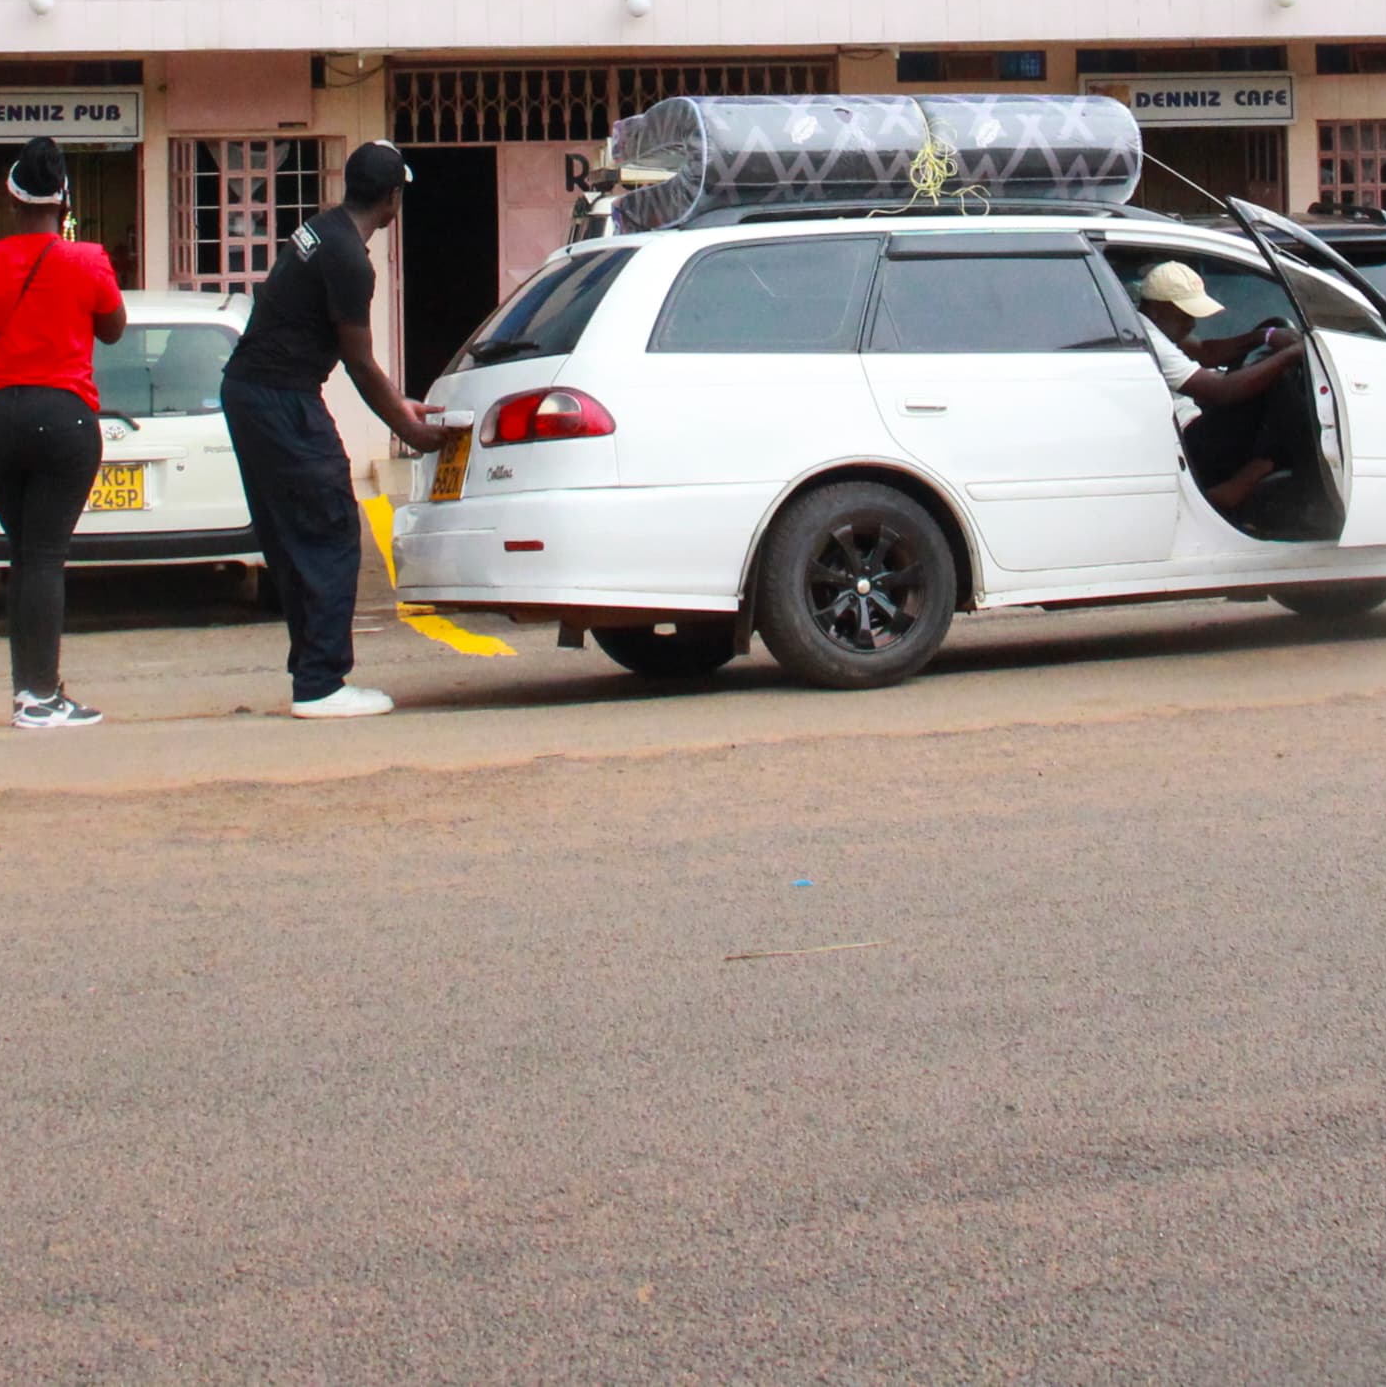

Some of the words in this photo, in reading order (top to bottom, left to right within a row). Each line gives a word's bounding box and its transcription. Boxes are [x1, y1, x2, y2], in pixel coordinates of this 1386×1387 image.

[1135, 91, 1221, 107] DENNIZ
[1234, 90, 1287, 105] CAFE
[74, 105, 121, 121] PUB
[101, 466, 141, 487] KCT
[92, 489, 139, 508] 245P
